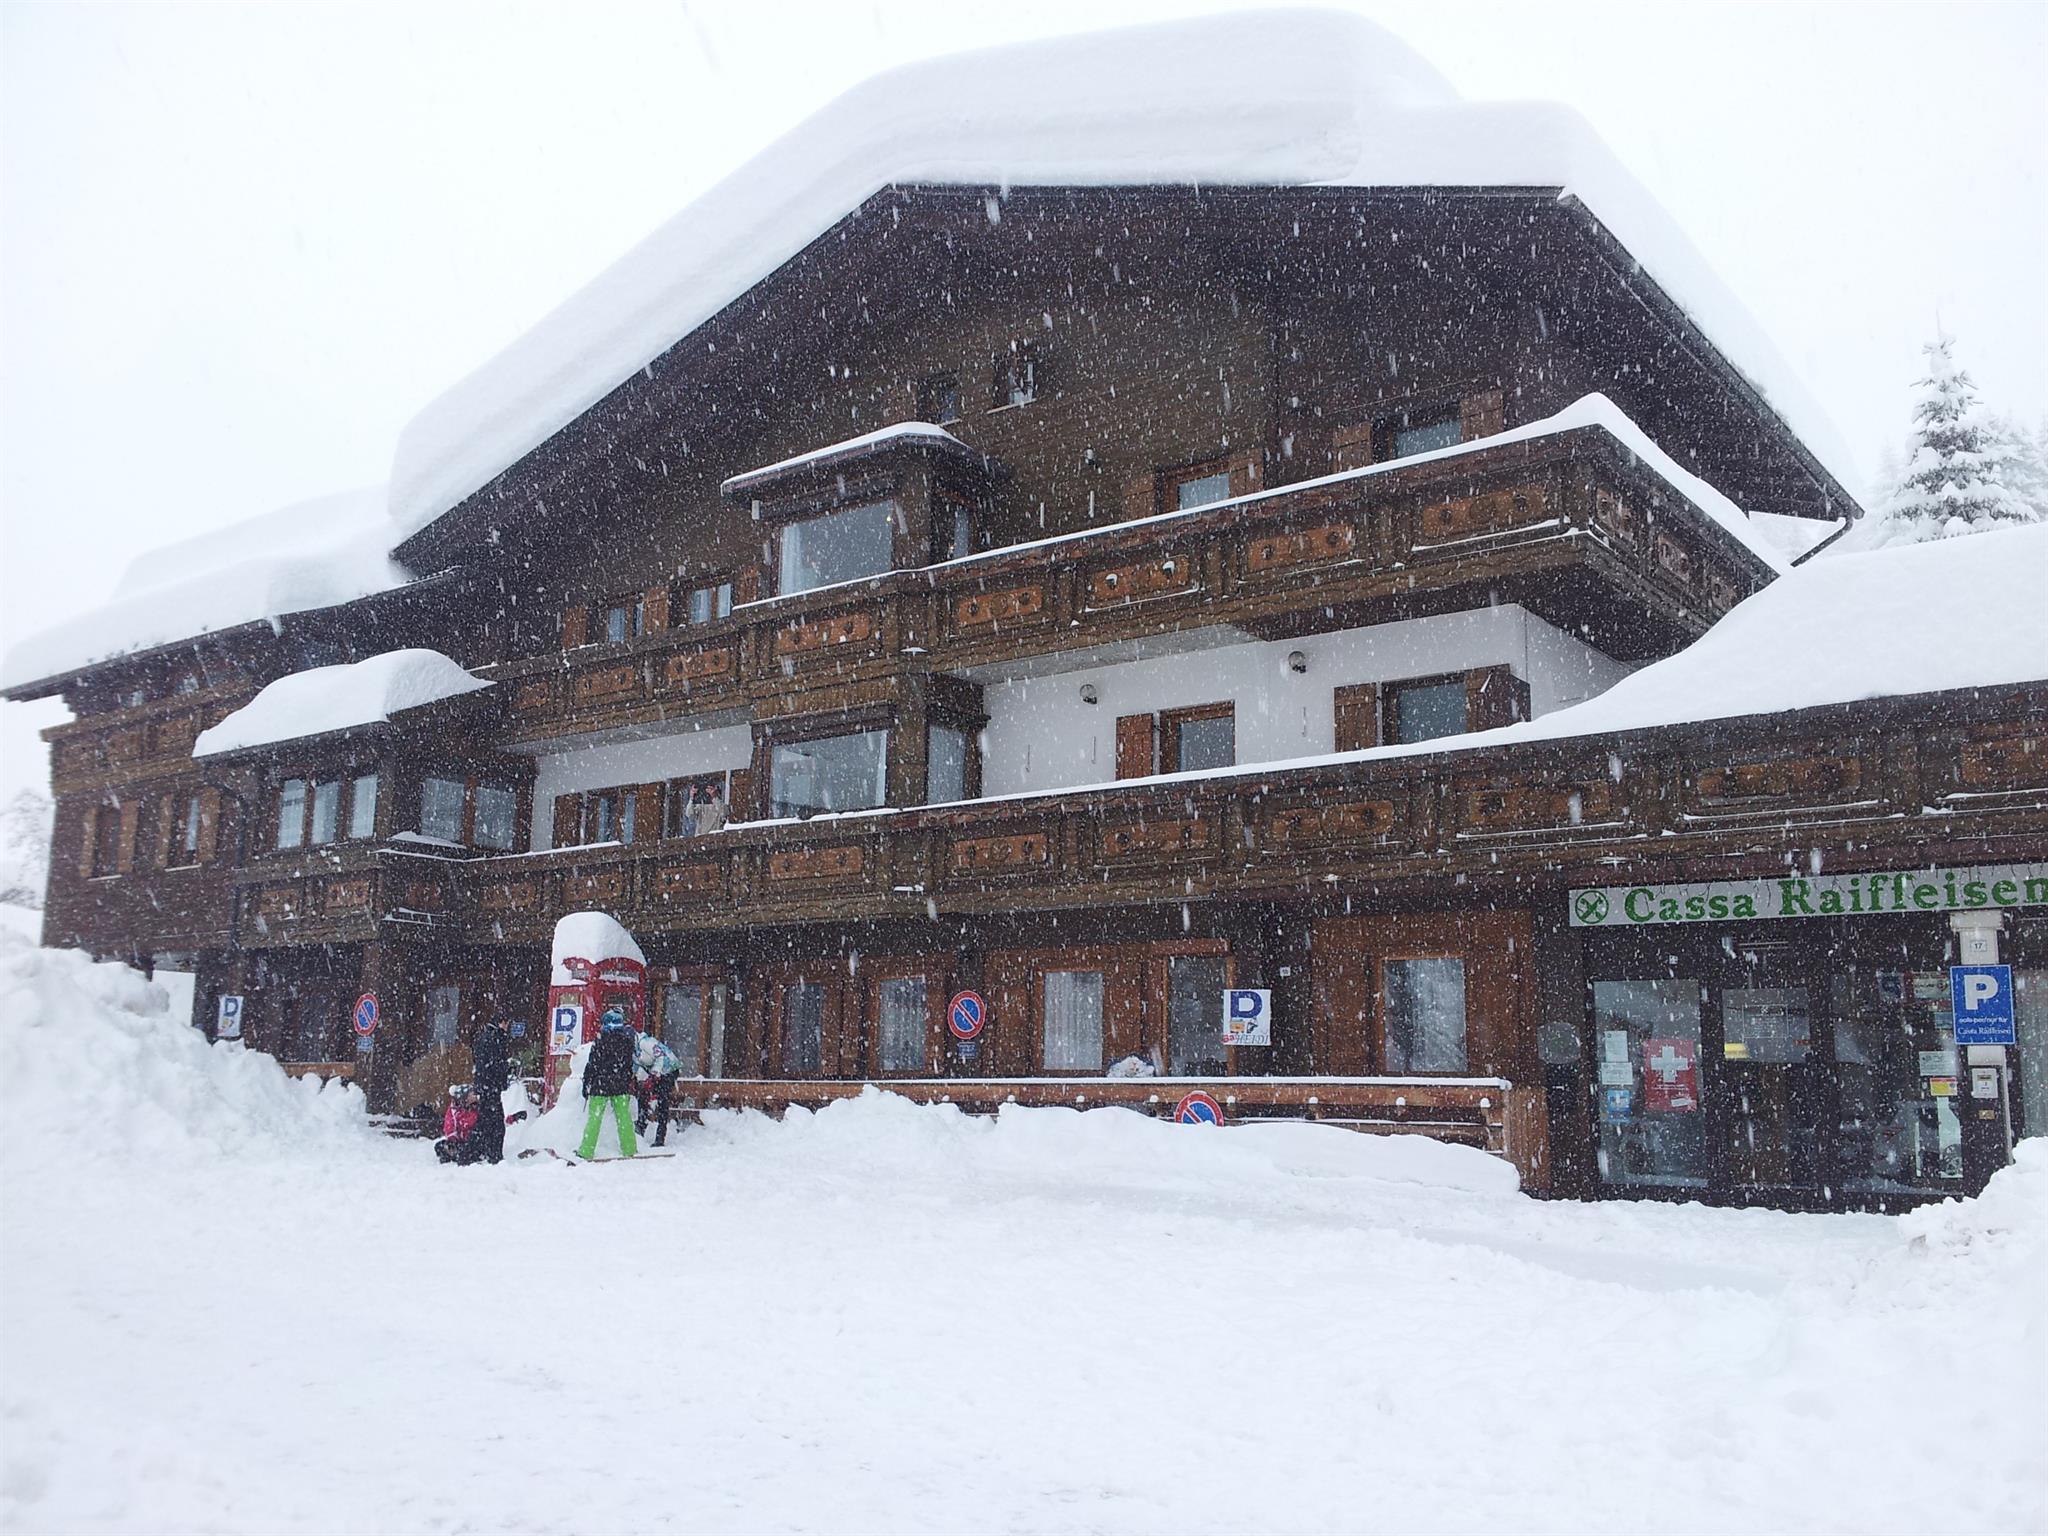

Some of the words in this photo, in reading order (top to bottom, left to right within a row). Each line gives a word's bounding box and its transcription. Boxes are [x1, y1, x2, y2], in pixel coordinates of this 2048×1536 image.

[1624, 888, 1757, 922] Cassa
[1777, 871, 2048, 915] Raiffeisen
[1230, 991, 1263, 1018] D
[1964, 975, 1998, 1010] P
[555, 1008, 577, 1032] D
